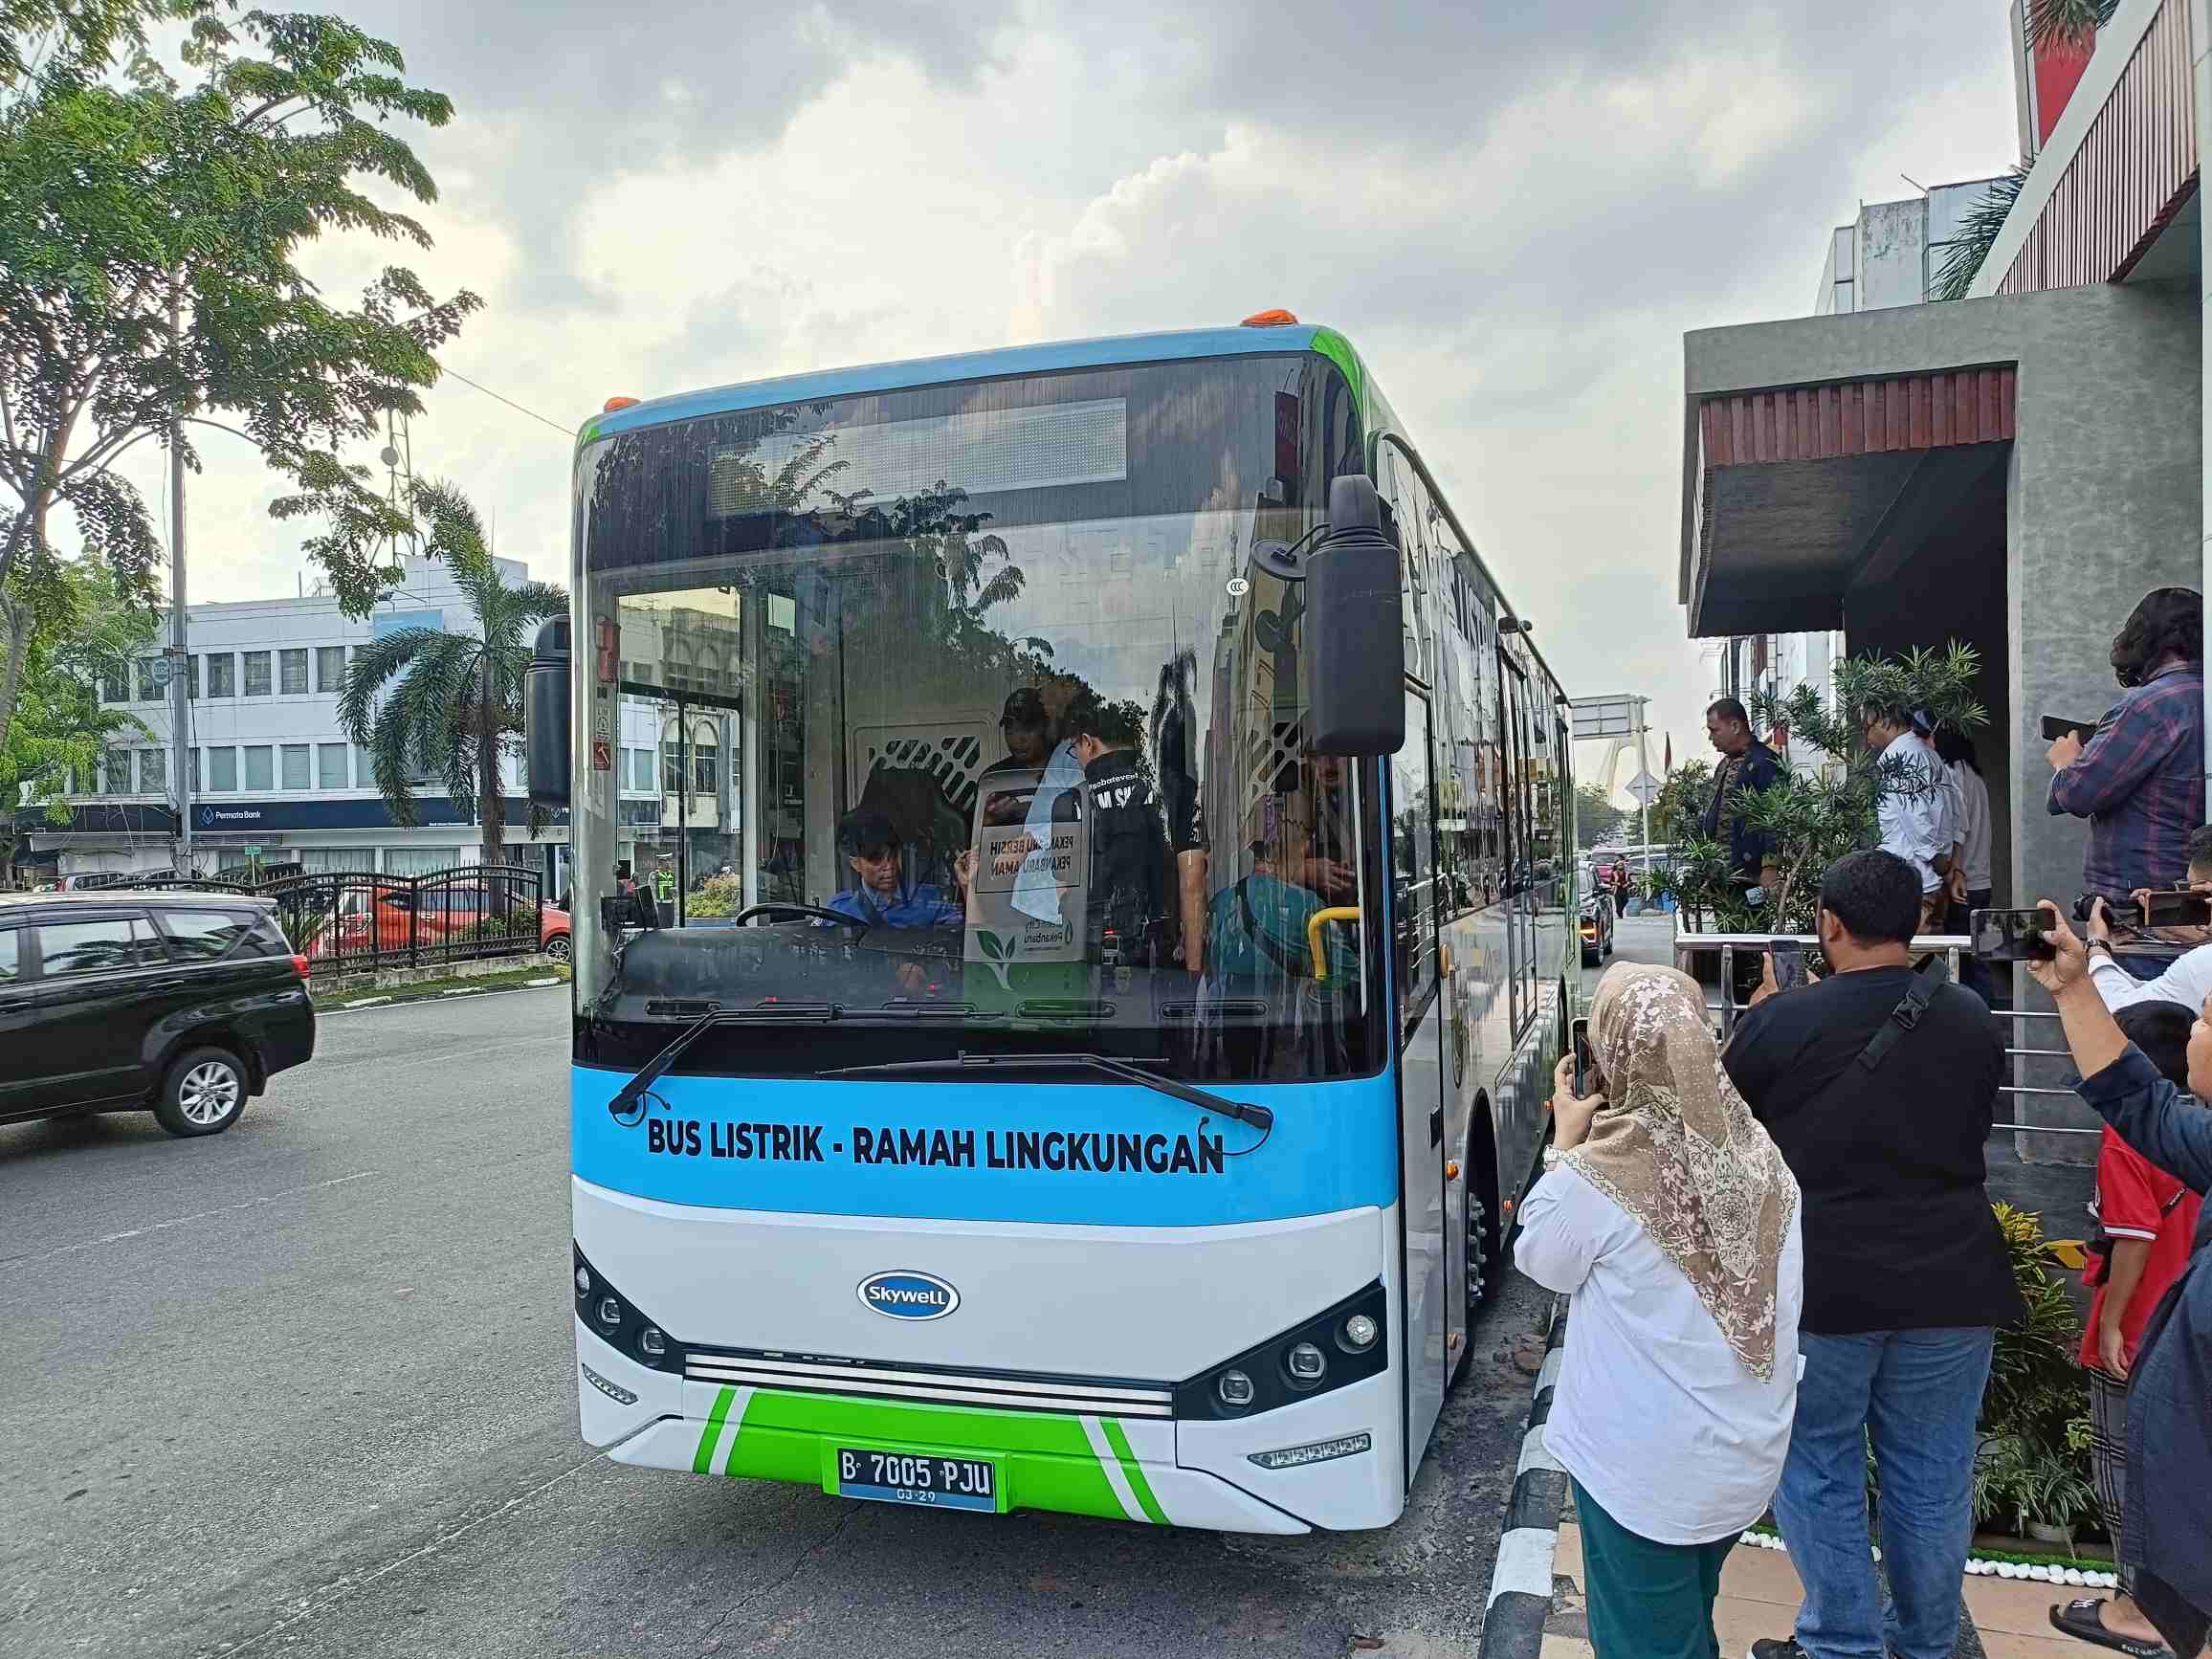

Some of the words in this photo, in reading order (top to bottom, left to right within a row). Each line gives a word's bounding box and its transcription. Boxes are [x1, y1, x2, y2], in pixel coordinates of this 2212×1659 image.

[215, 811, 243, 820] Permata
[244, 810, 261, 819] Bank
[648, 1117, 702, 1157] BUS
[710, 1121, 825, 1162] LISTRIK
[832, 1142, 843, 1153] -
[852, 1127, 975, 1167] RAMAH
[986, 1130, 1225, 1174] LINGKUNGAN
[842, 1451, 856, 1480] B
[872, 1454, 932, 1488] 7005
[942, 1461, 990, 1494] PJU
